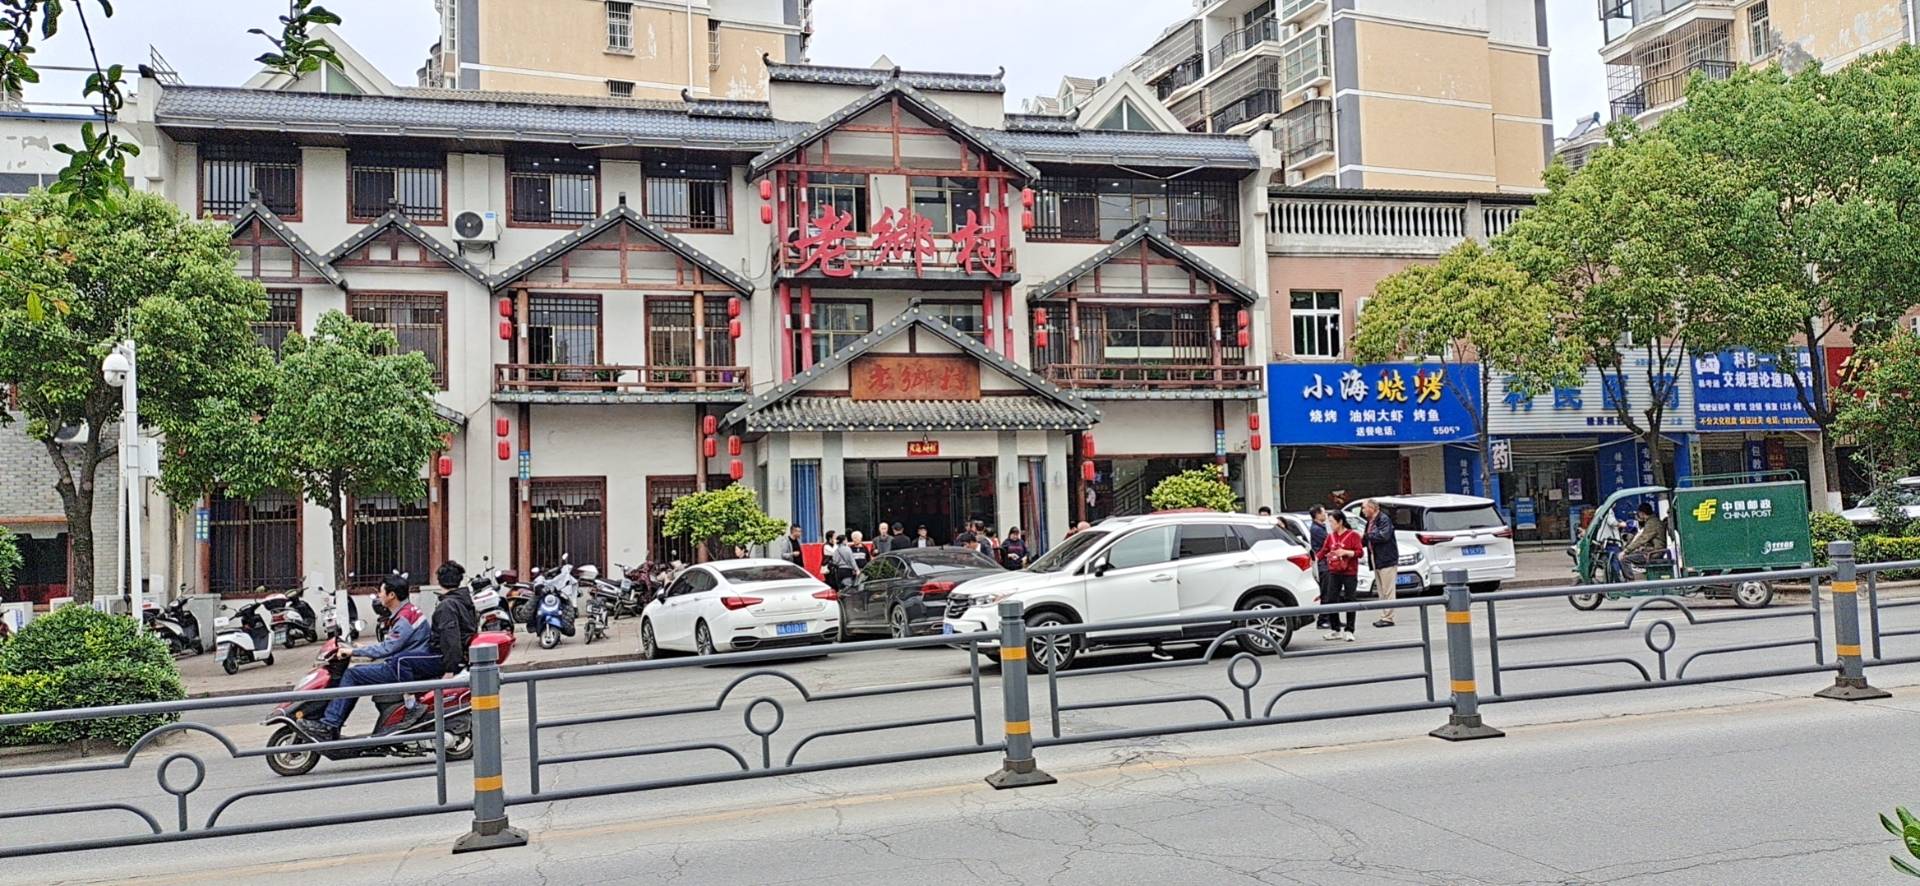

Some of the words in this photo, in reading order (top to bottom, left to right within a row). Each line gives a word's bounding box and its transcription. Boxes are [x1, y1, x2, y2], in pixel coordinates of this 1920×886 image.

[1303, 368, 1444, 404] 小海烧烤
[1309, 409, 1338, 423] 烧烤
[1350, 409, 1404, 423] 油焖大虾
[1413, 409, 1440, 423] 烤鱼
[1492, 442, 1509, 469] 药
[1721, 499, 1772, 511] 中国邮政
[1723, 511, 1750, 519] CHINA
[1751, 509, 1772, 518] POST
